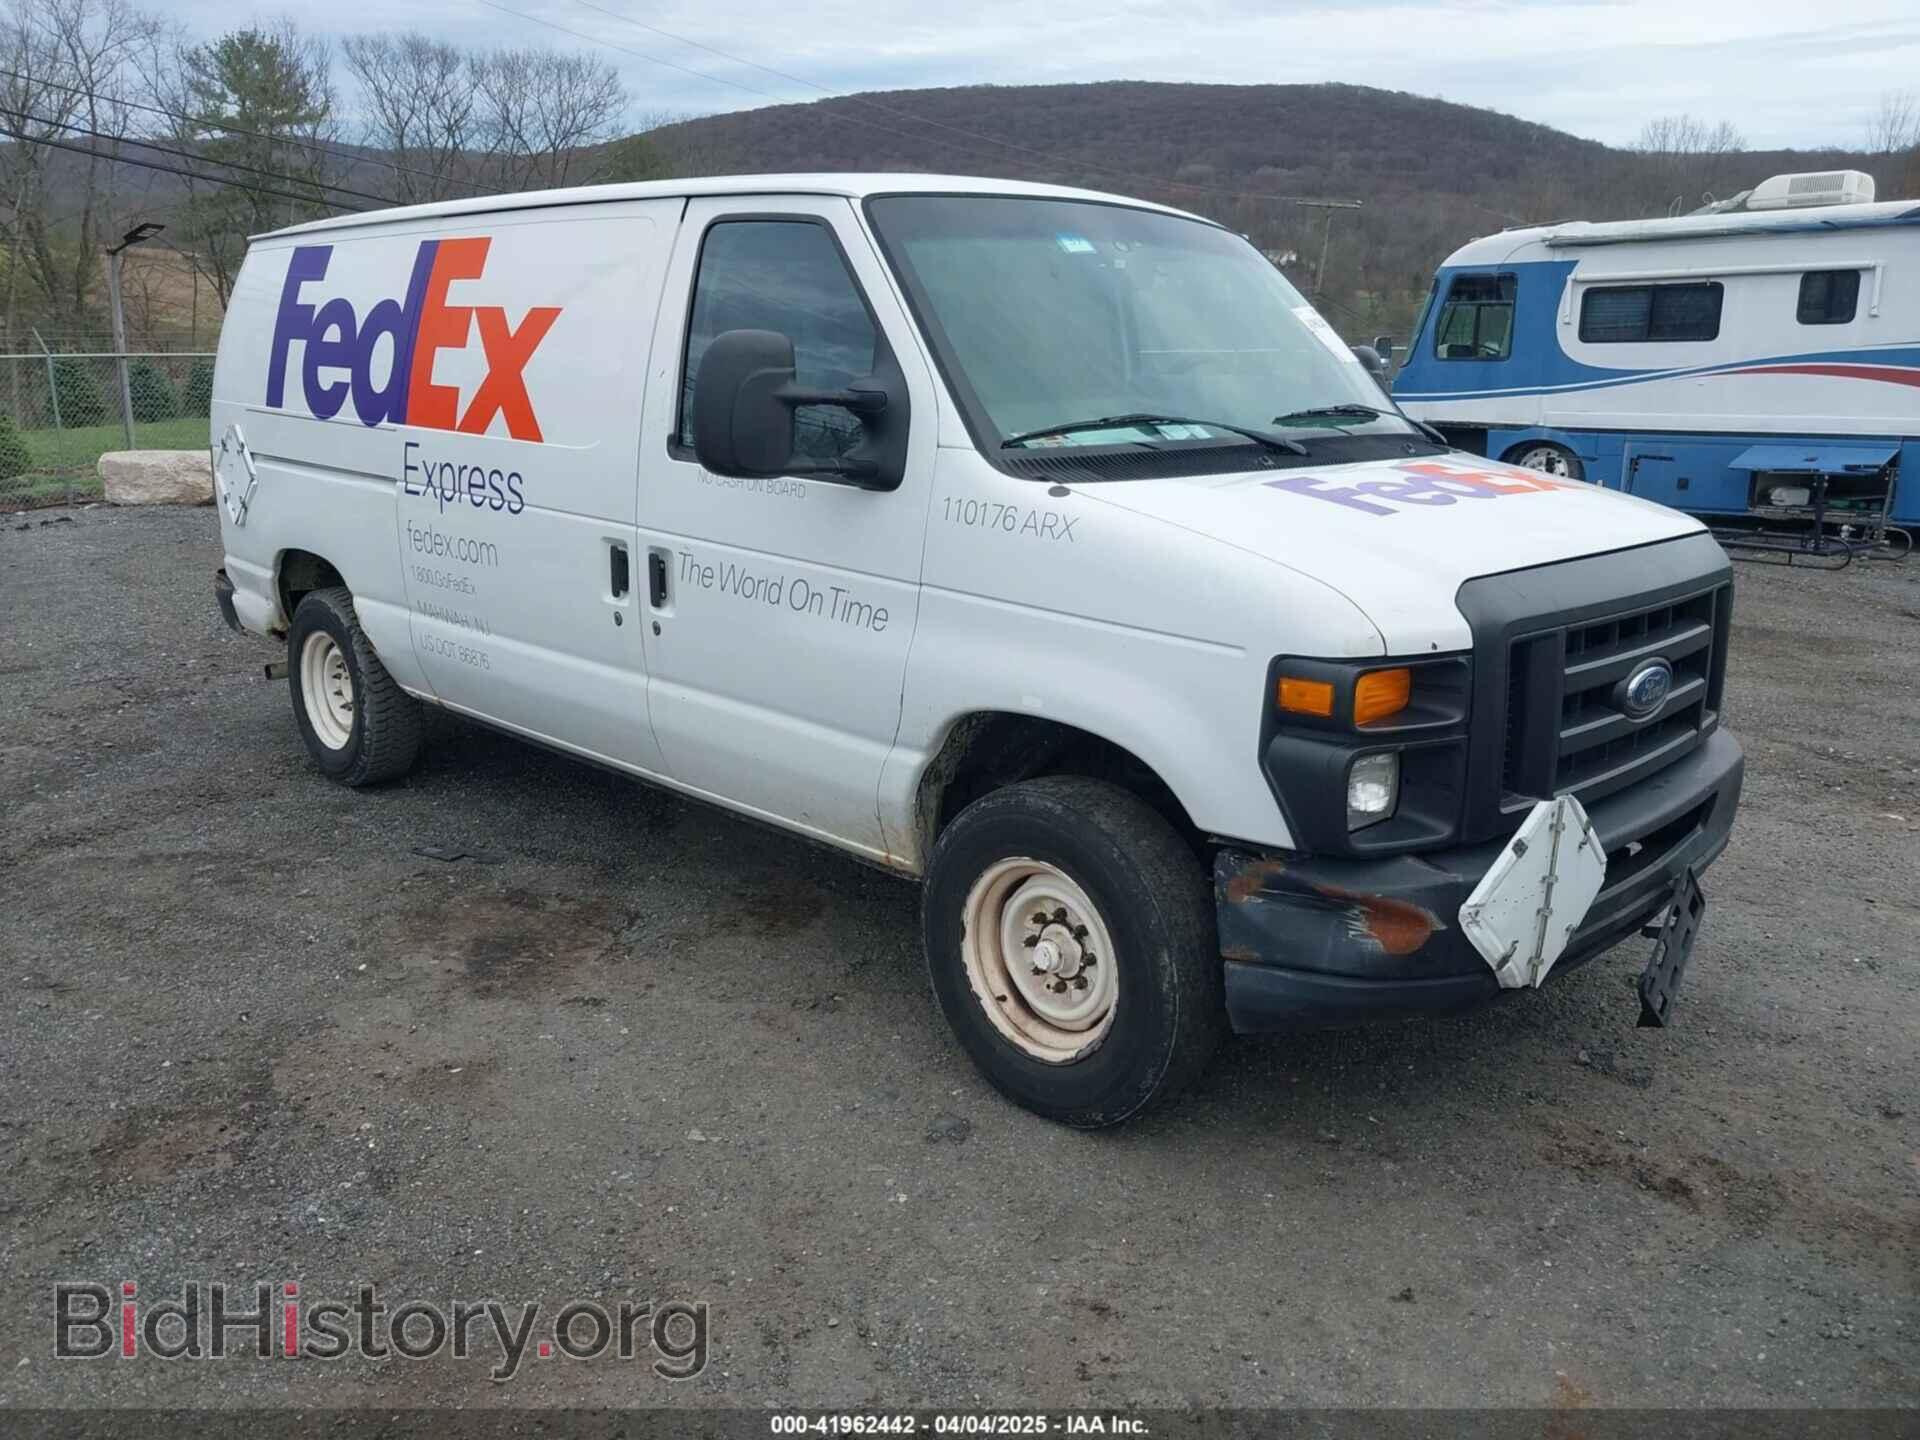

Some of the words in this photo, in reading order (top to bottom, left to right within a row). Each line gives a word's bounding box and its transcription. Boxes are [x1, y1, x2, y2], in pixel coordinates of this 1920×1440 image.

[266, 237, 564, 443] FedEx
[404, 442, 525, 514] Express
[766, 480, 806, 498] BOARD
[1261, 463, 1584, 516] FedEx
[407, 520, 498, 566] fedex.com
[944, 497, 1017, 532] 110176
[1020, 510, 1079, 542] ARX
[678, 551, 714, 588] The
[719, 561, 784, 605] World
[789, 578, 823, 617] On
[829, 586, 888, 632] Time
